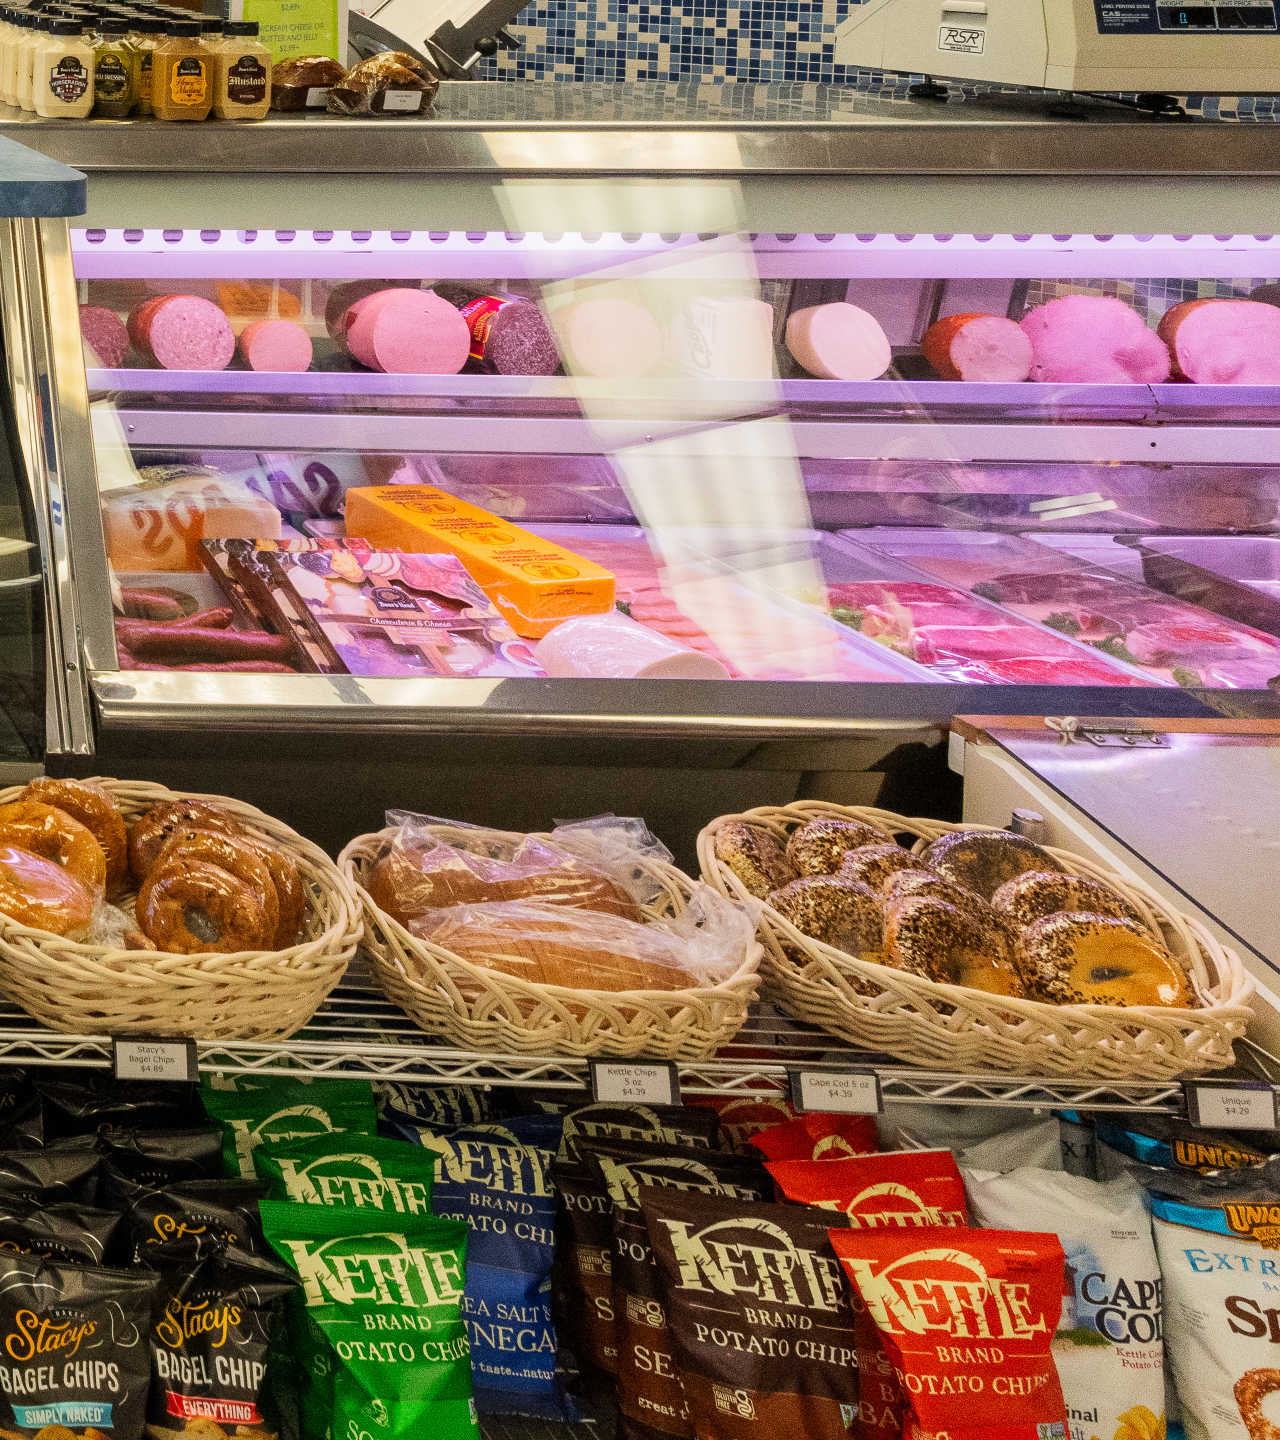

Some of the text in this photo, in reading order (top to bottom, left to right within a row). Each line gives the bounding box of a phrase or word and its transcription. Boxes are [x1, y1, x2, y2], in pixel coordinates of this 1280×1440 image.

[944, 29, 980, 46] RSR
[228, 75, 266, 87] Mustard
[129, 1055, 176, 1065] Bagel Chips
[136, 1046, 167, 1056] Stacy's
[607, 1068, 657, 1078] Kettle Chips
[809, 1080, 850, 1091] Cape Cod
[1220, 1096, 1251, 1108] Unique
[469, 1192, 534, 1217] BRAND
[279, 1232, 466, 1309] KETTLE
[656, 1216, 844, 1314] KETTLE
[839, 1248, 1051, 1340] KETTLE
[155, 1296, 242, 1349] Stacy's
[496, 1303, 542, 1323] SALT
[743, 1307, 814, 1334] BRAND
[362, 1314, 433, 1334] BRAND
[4, 1308, 99, 1362] Stacy's
[693, 1322, 859, 1369] POTATO CHIPS
[422, 1336, 469, 1362] CHIPS
[935, 1346, 1005, 1364] BRAND
[1115, 1347, 1146, 1359] Kettle
[155, 1347, 267, 1391] BAGEL CHIP
[1121, 1358, 1152, 1370] Potato
[63, 1360, 121, 1394] CHIPS
[24, 1405, 102, 1426] SIMPLY NAKED
[183, 1398, 252, 1420] EVERYTHING
